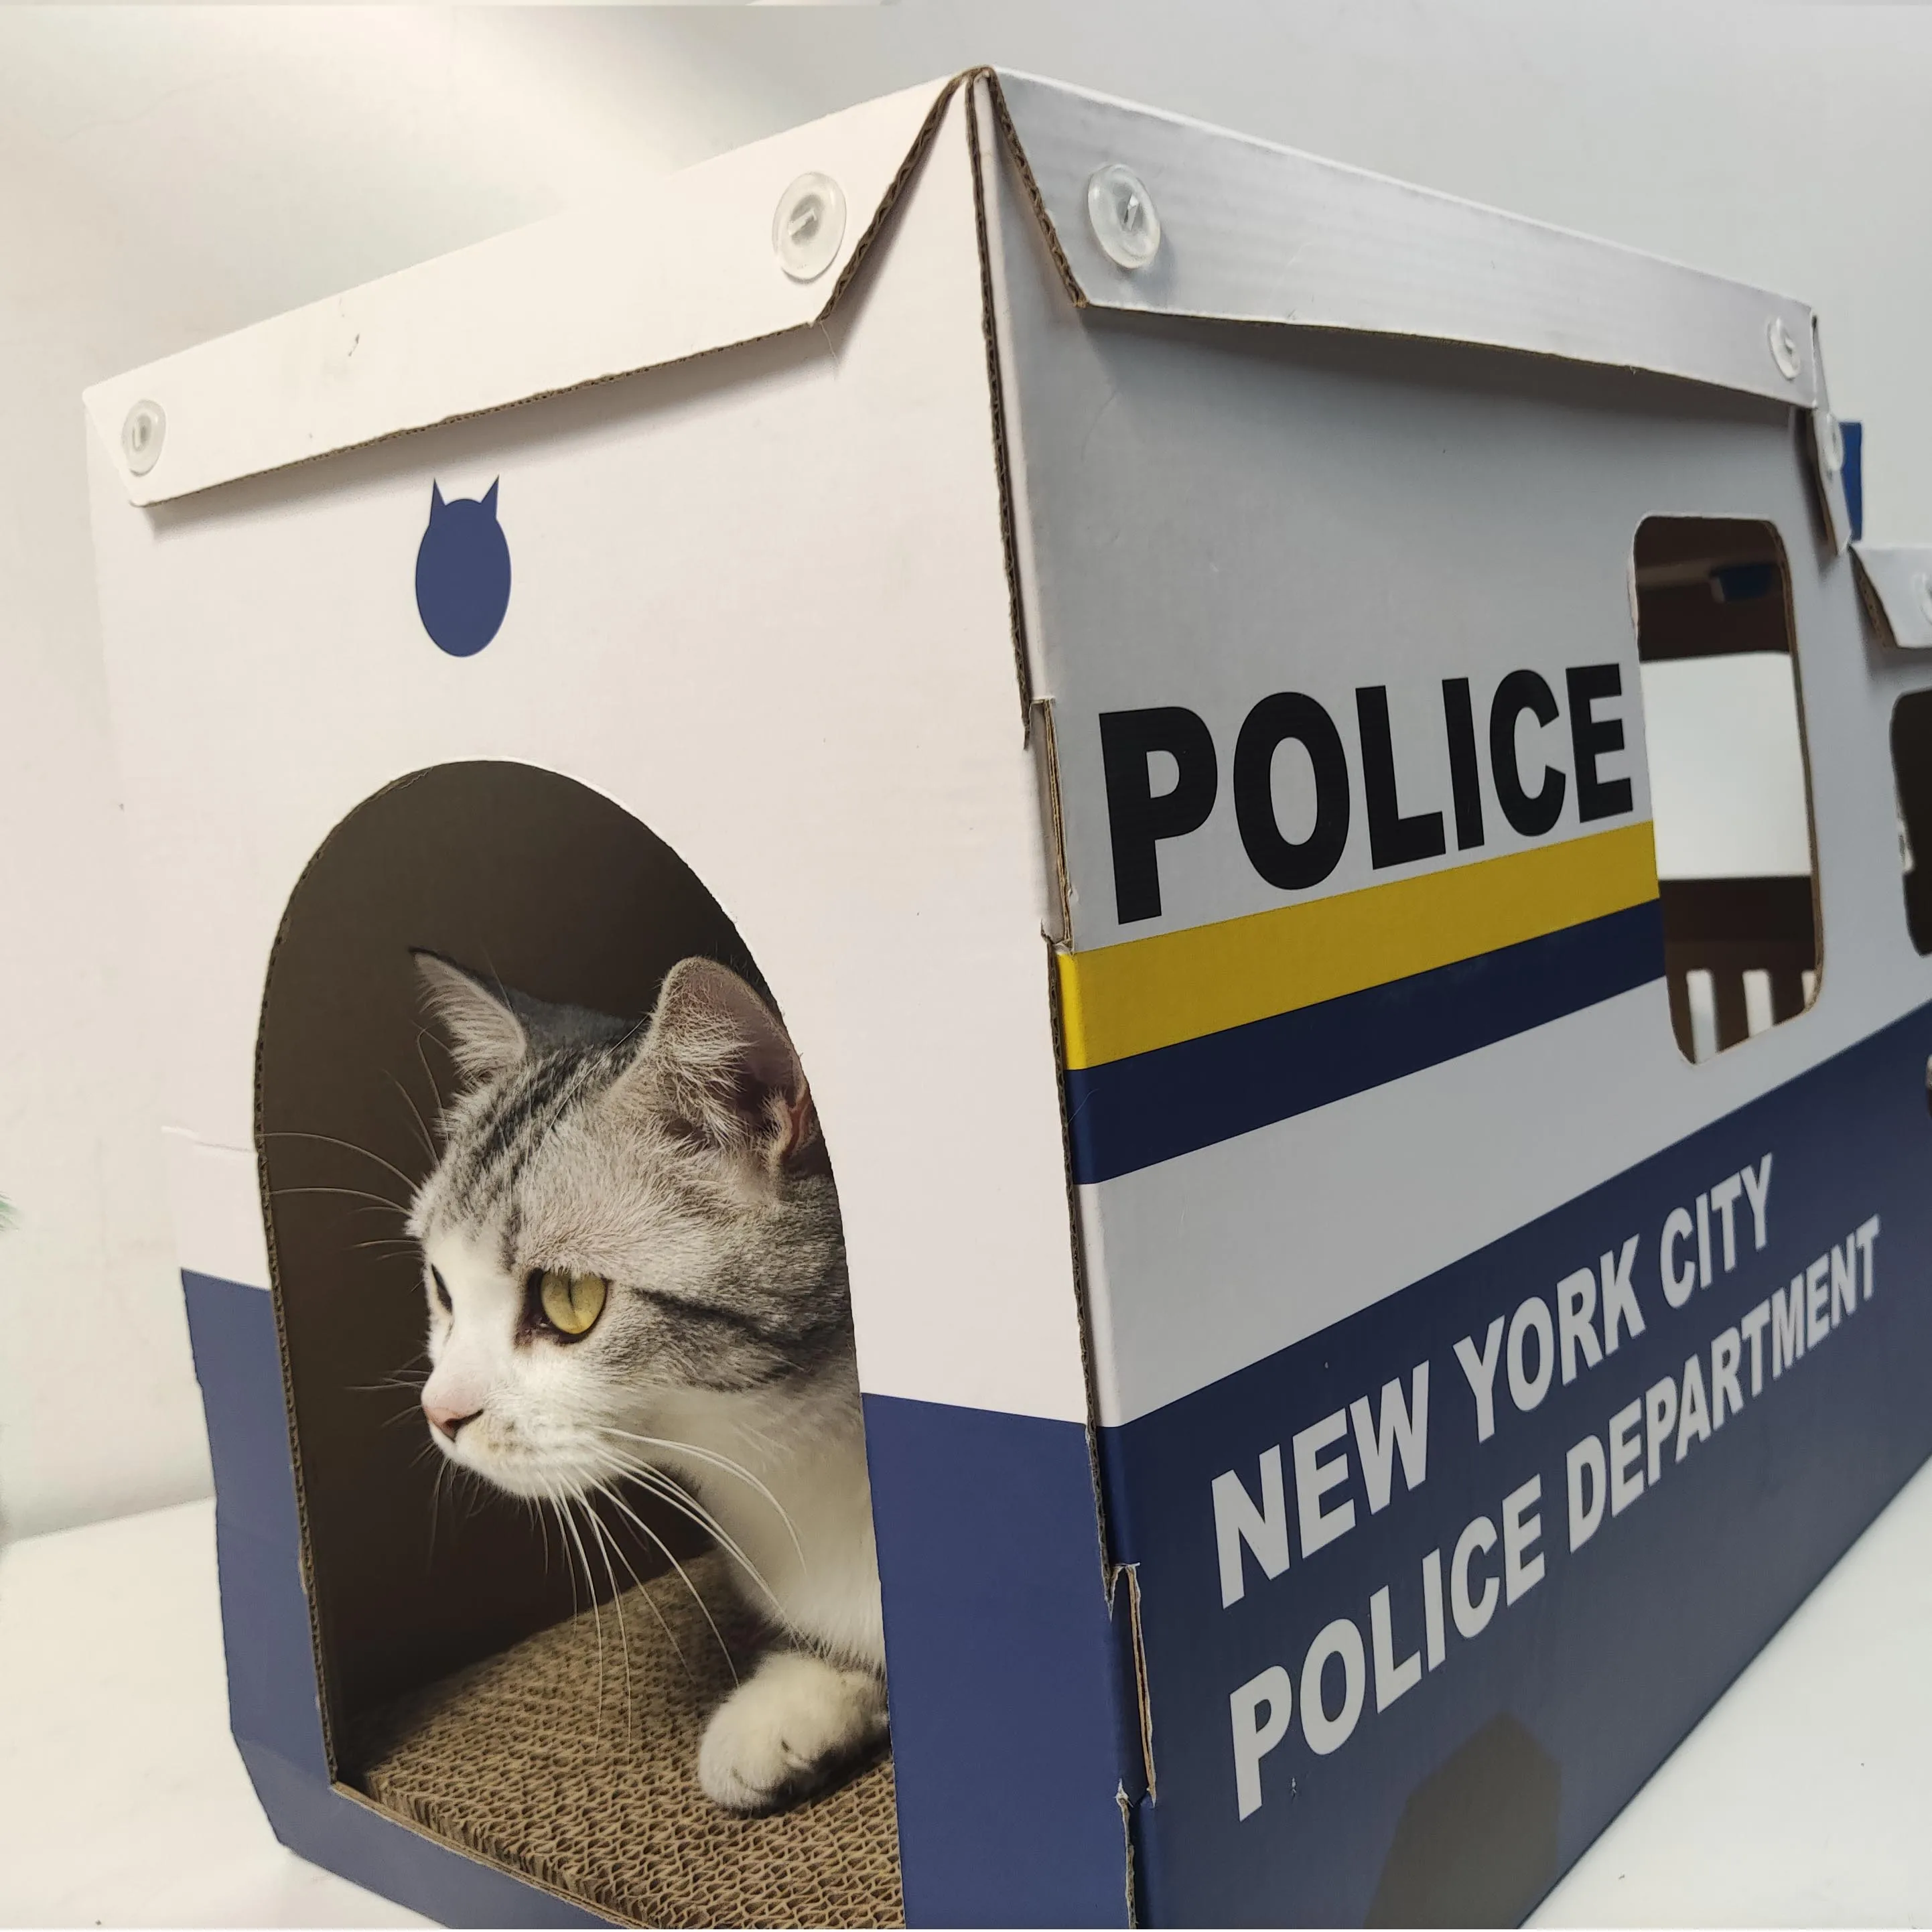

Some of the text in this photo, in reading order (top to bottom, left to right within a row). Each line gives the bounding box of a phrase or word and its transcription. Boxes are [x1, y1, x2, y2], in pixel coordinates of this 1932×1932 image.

[1099, 663, 1634, 925] POLICE
[1211, 1152, 1773, 1610] NEW YORK CITY
[1229, 1213, 1880, 1822] POLICE DEPARTMENT
